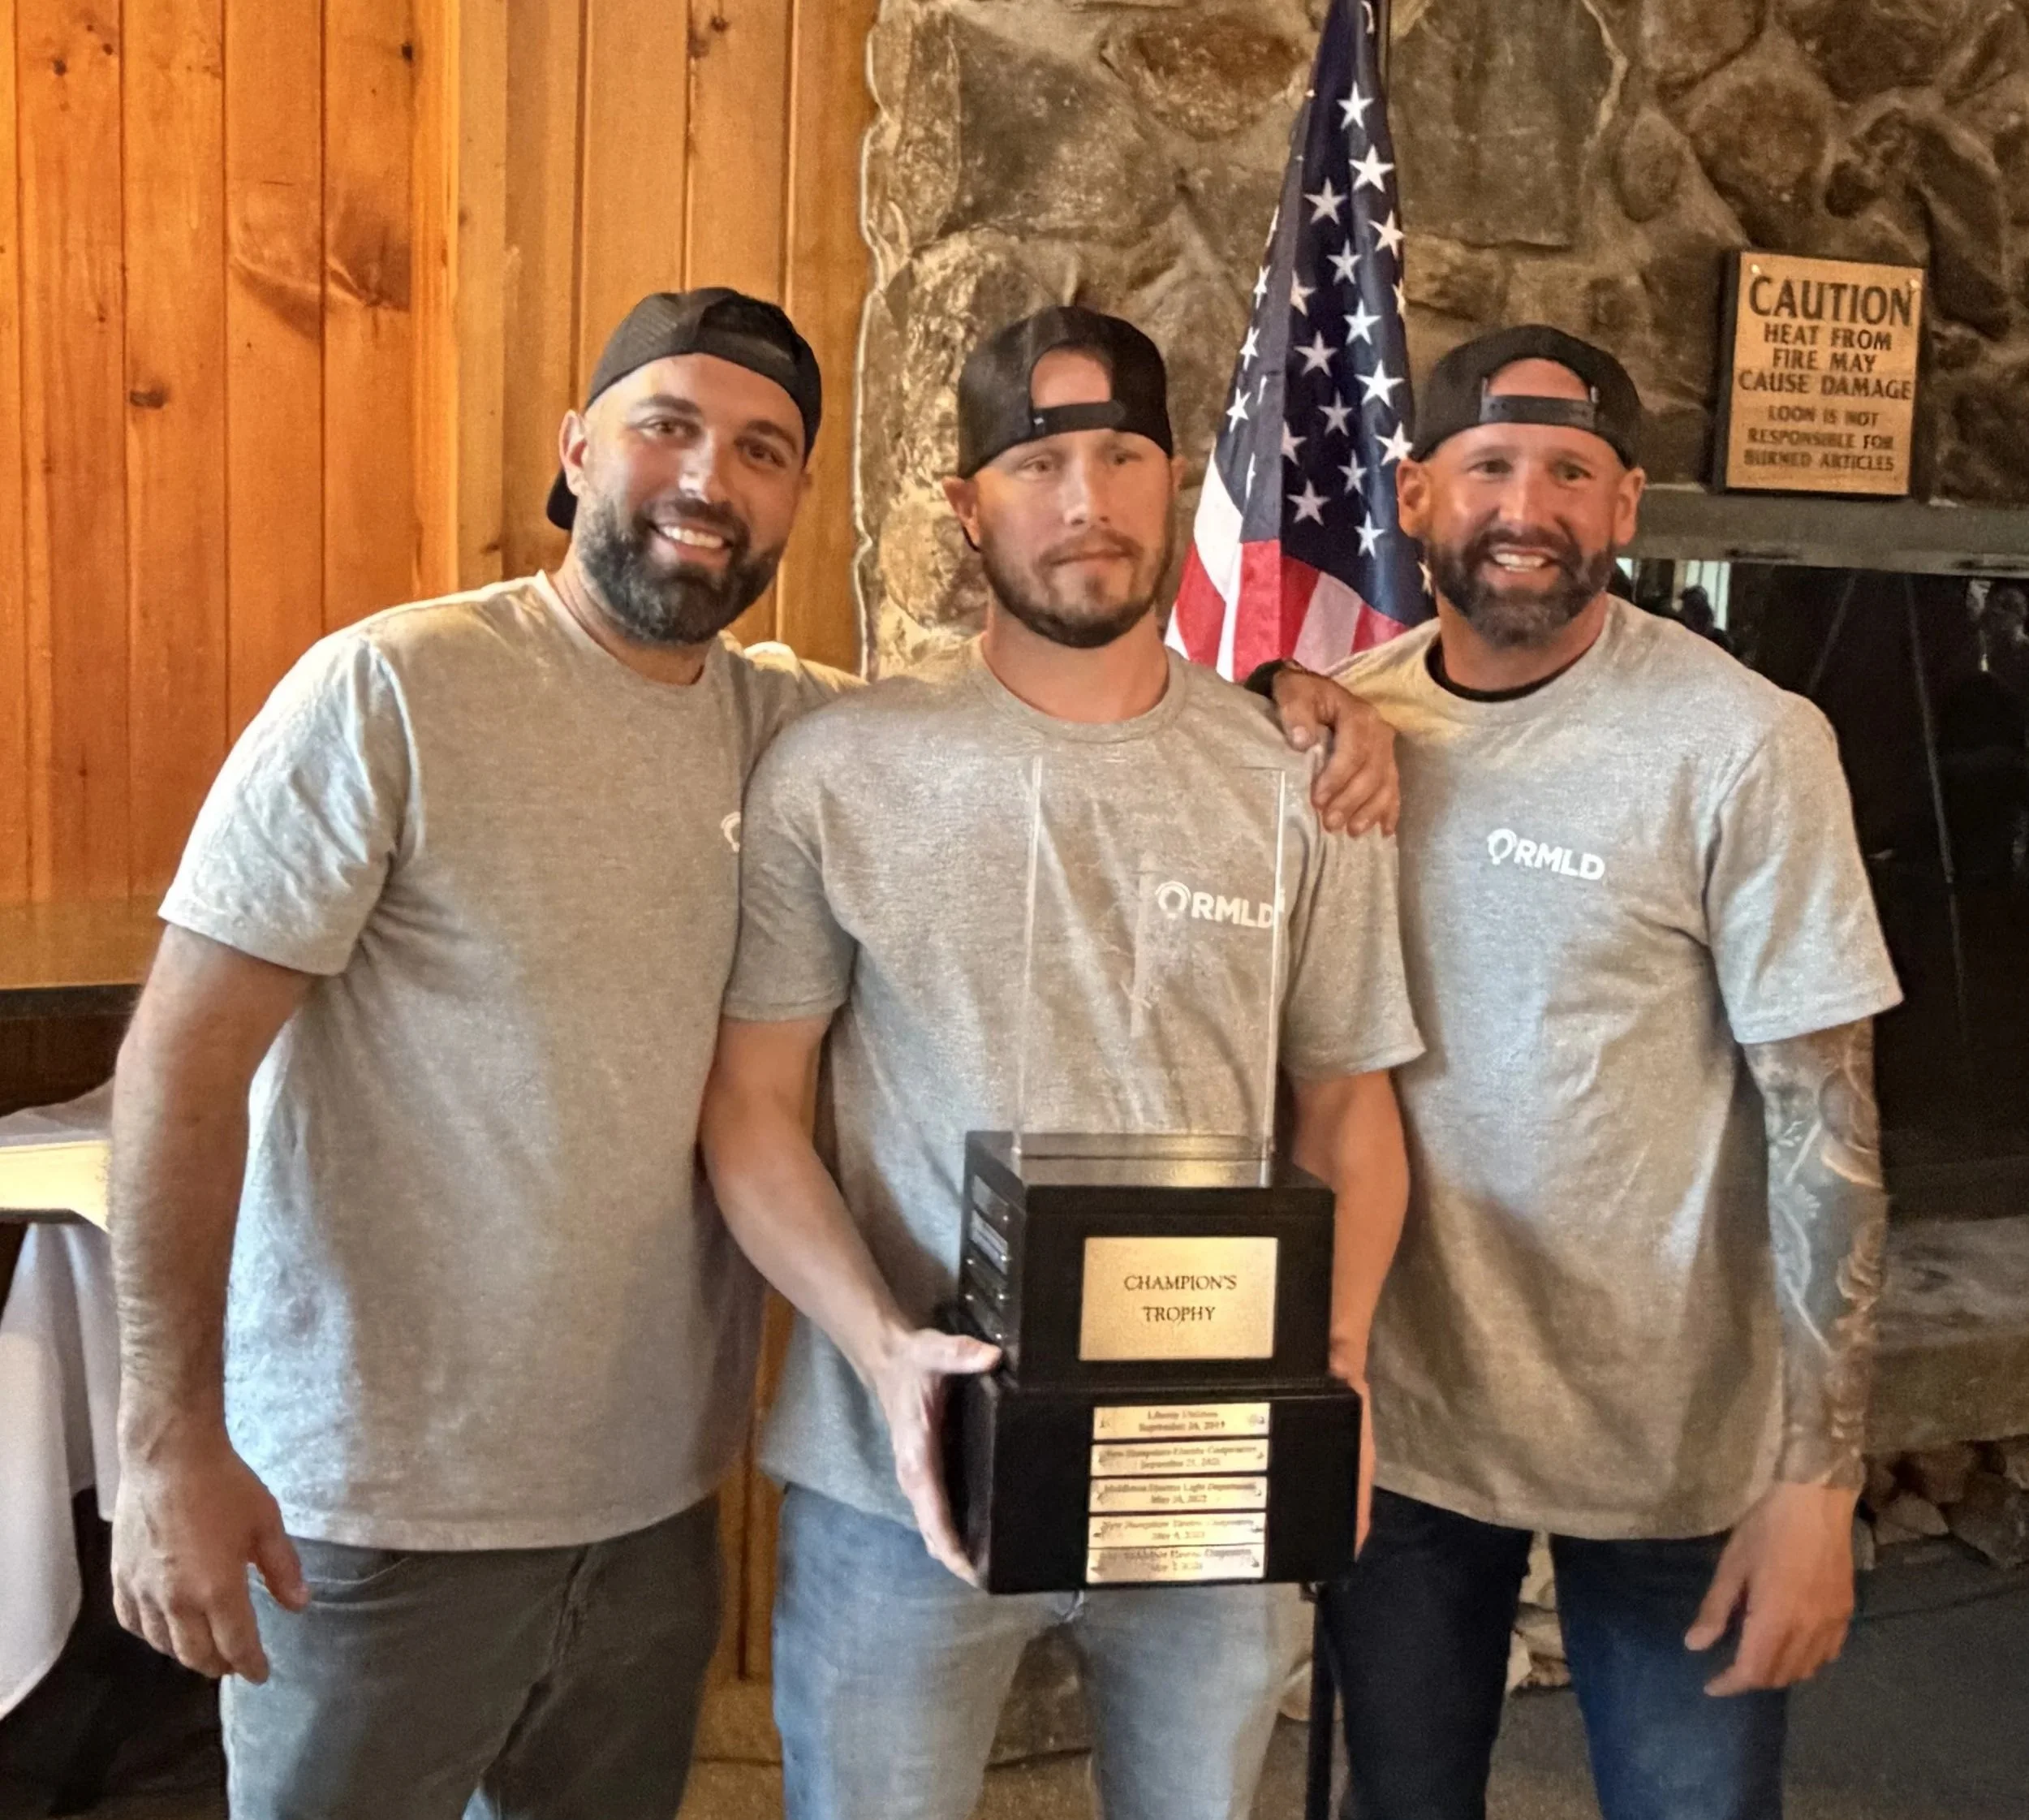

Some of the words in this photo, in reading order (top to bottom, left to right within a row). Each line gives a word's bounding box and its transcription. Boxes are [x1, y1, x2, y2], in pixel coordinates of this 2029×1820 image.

[1748, 275, 1912, 328] CAUTION
[1764, 322, 1820, 345] HEAT
[1830, 326, 1893, 351] FROM
[1772, 347, 1819, 370] FIRE
[1829, 351, 1877, 374] MAY
[1738, 369, 1811, 394] CAUSE
[1820, 374, 1912, 400] DAMAGE
[1823, 408, 1837, 425] IS
[1845, 411, 1880, 427] NOT
[1747, 427, 1855, 449] RESPONSIBLE
[1863, 433, 1894, 451] FOR
[1743, 449, 1812, 468] BURNED
[1820, 452, 1895, 472] ARTICLES
[1514, 838, 1605, 881] RMLD
[1191, 891, 1286, 929] RMLD
[1123, 1274, 1238, 1292] CHAMPION'S
[1142, 1305, 1216, 1323] TROPHY
